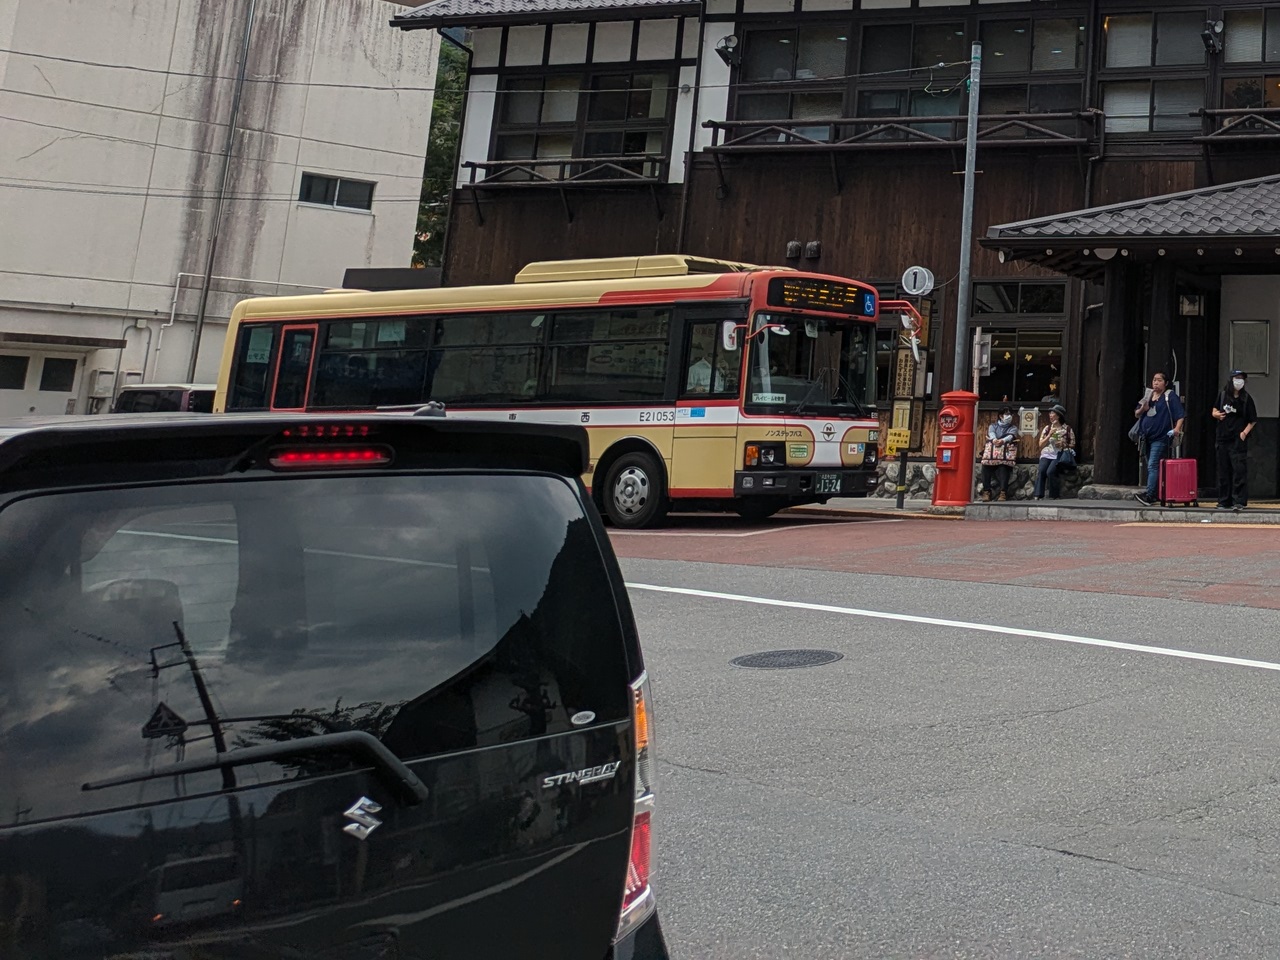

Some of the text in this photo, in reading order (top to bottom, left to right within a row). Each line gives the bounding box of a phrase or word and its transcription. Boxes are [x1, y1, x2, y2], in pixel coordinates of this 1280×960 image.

[912, 270, 918, 290] 1
[580, 412, 590, 423] 西
[639, 411, 675, 422] E21053
[820, 478, 841, 492] 13-24
[542, 760, 622, 789] STINGRAY
